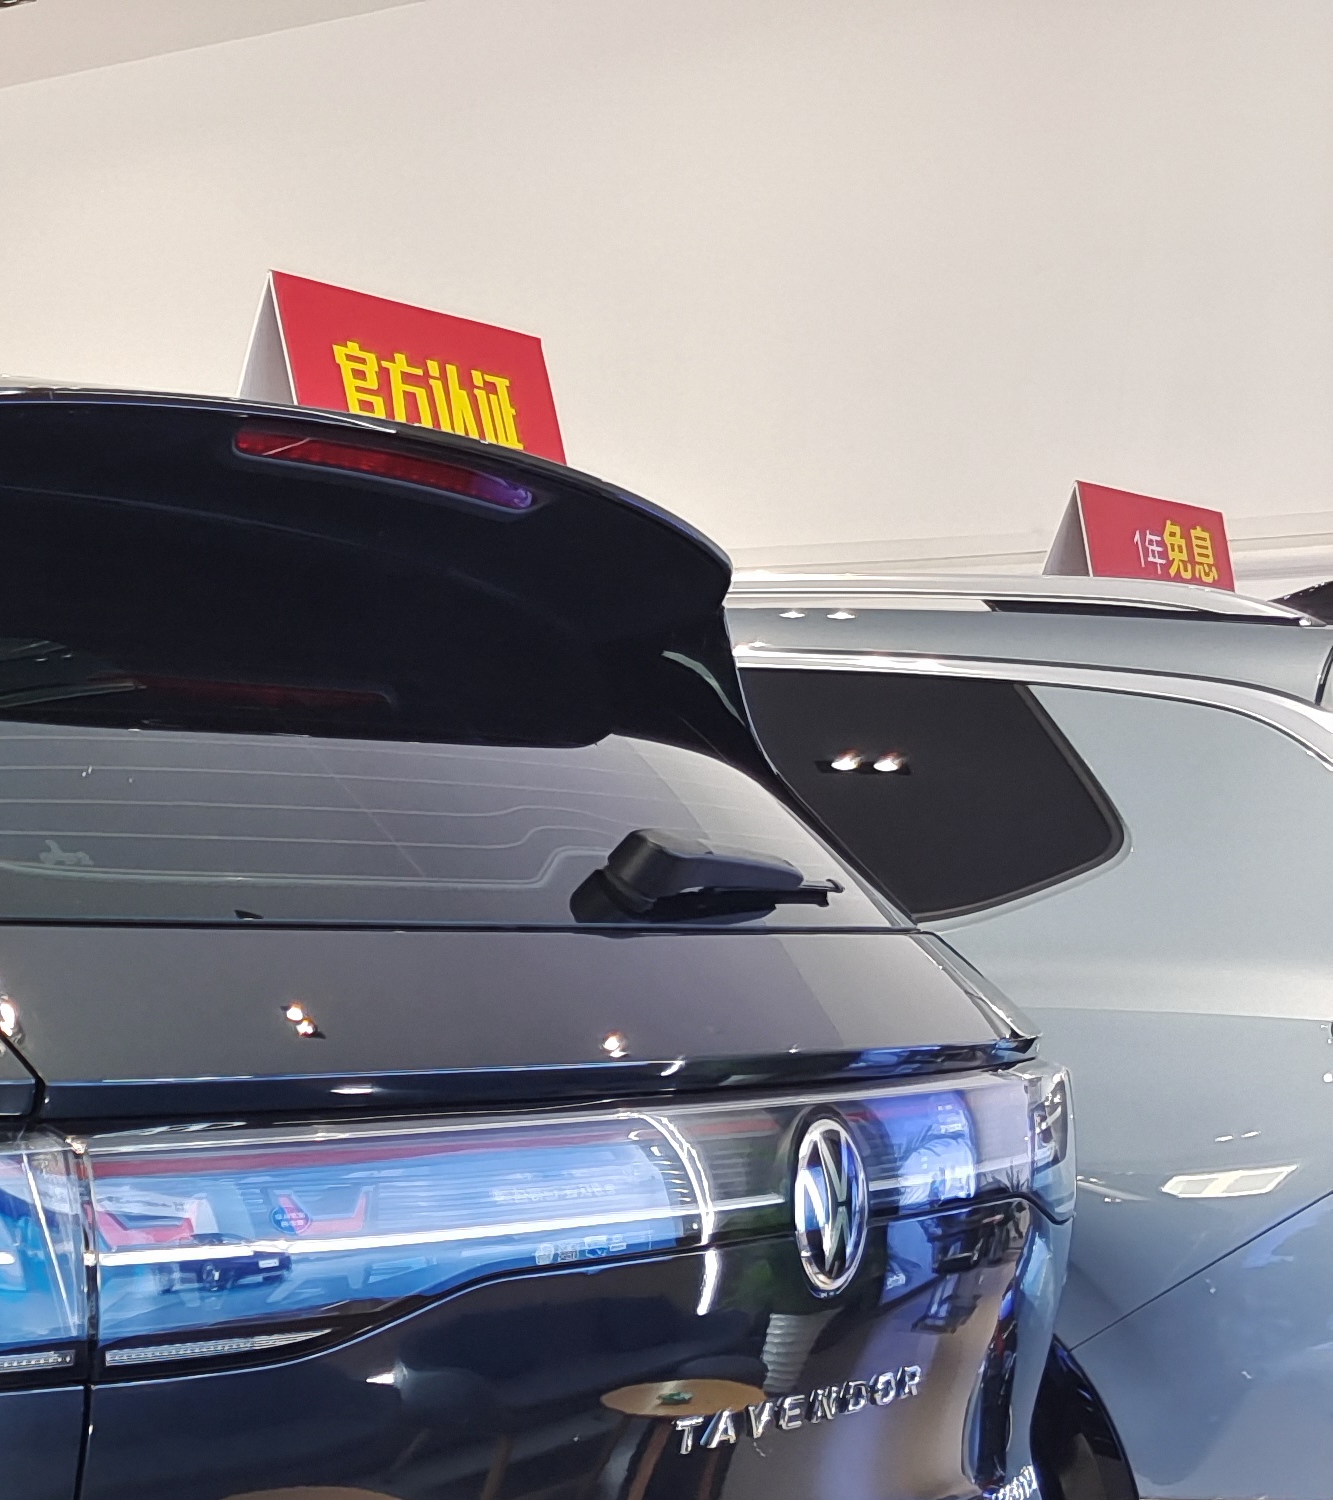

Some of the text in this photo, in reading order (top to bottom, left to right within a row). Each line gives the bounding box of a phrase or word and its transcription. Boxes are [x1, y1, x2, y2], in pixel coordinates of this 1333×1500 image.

[332, 340, 524, 451] 官方认证
[1133, 519, 1219, 584] 1年免息
[675, 1364, 923, 1455] TAVENDOR
